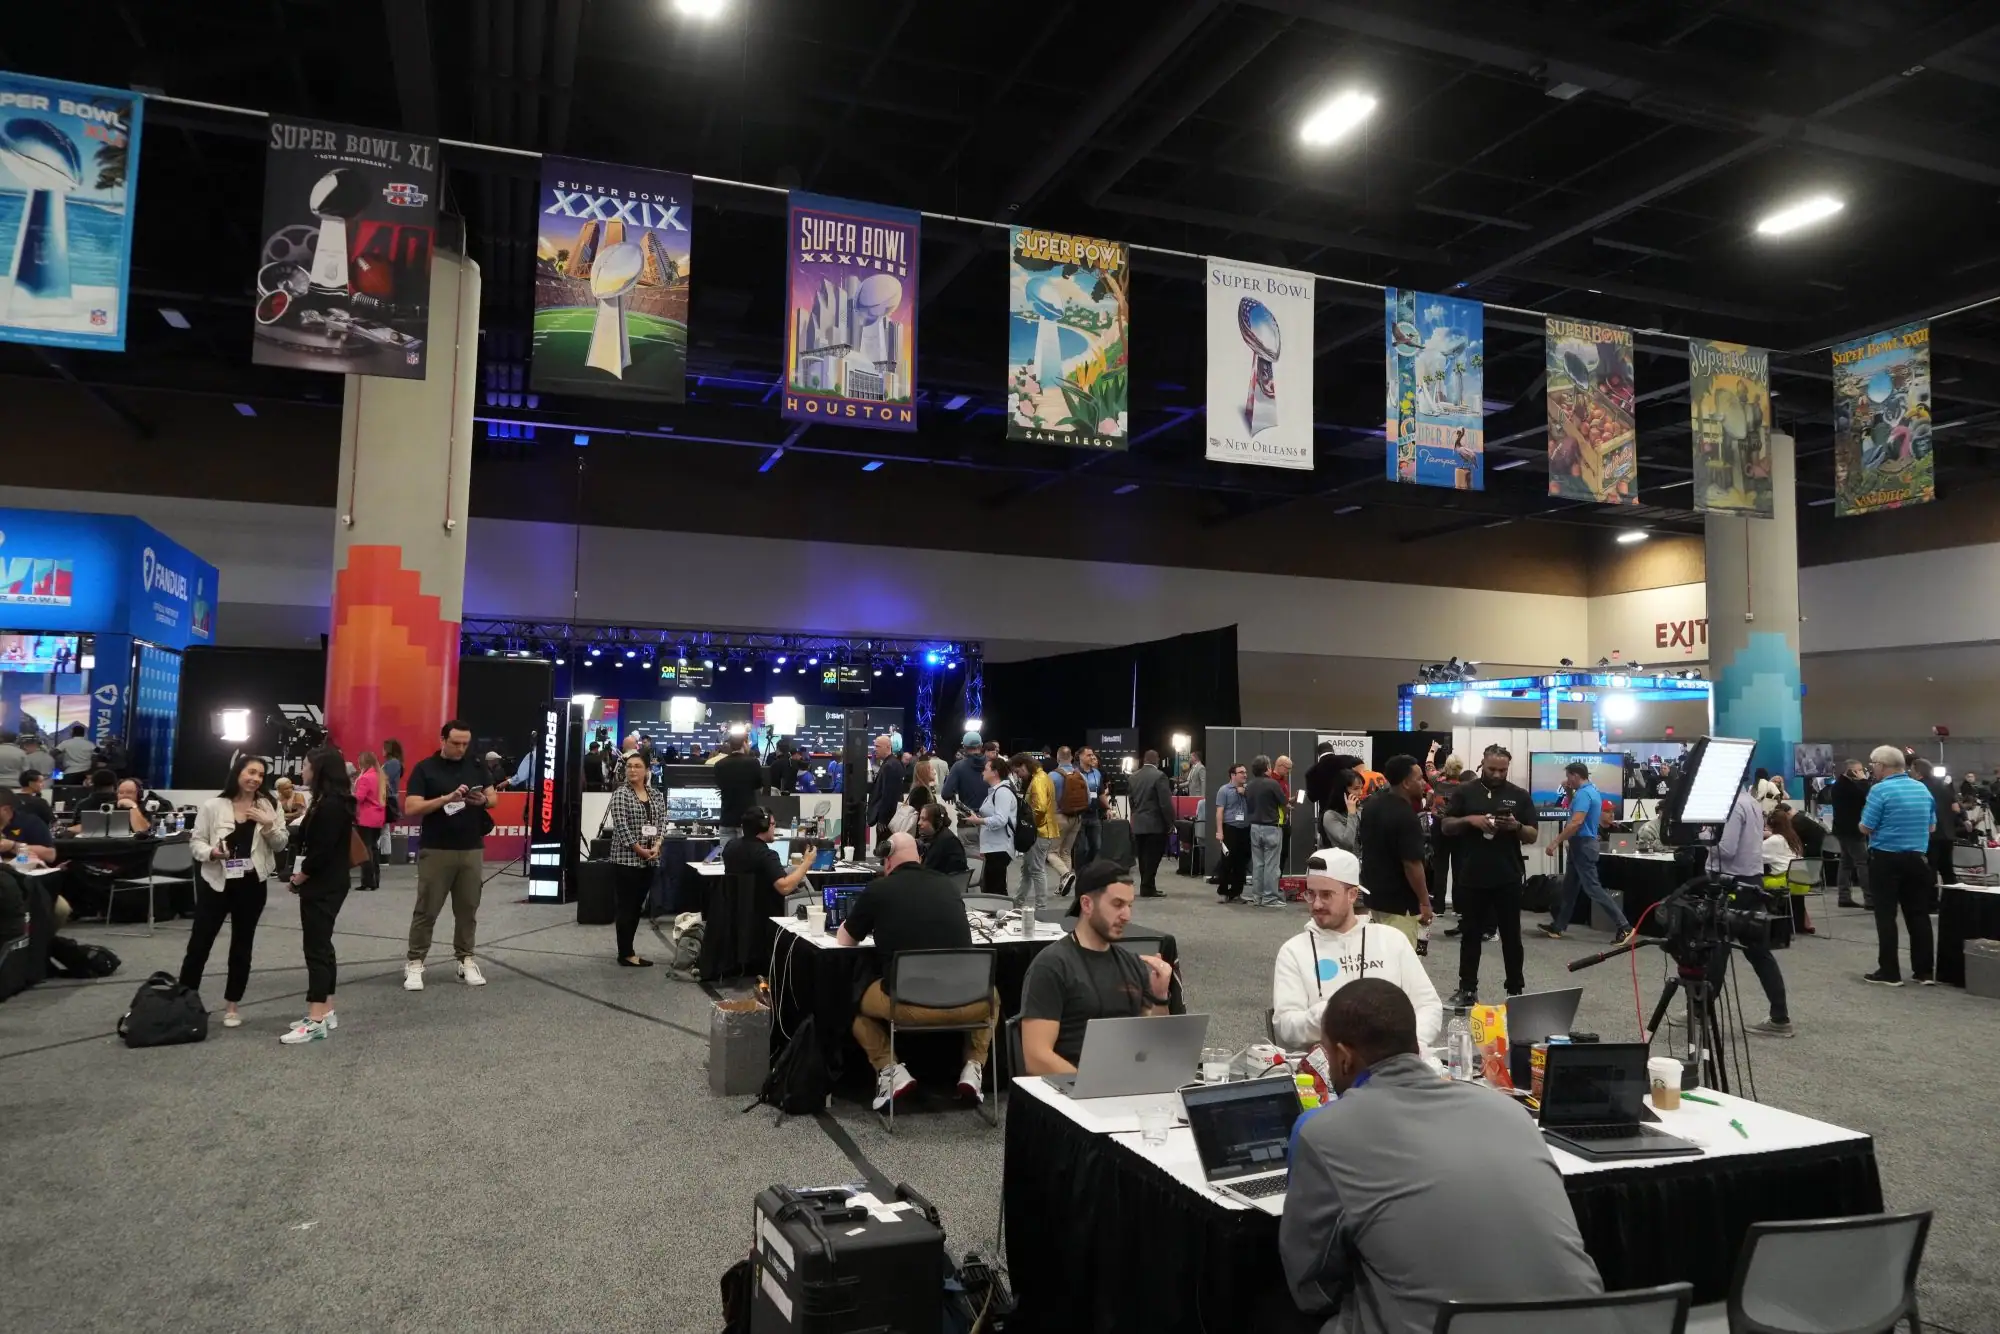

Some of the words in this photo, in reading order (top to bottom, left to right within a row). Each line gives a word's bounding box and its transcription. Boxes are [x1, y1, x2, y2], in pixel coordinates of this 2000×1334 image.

[58, 99, 127, 131] BOWL
[270, 123, 337, 151] SUPER
[345, 134, 401, 162] BOWL
[408, 143, 433, 172] XL
[557, 180, 619, 196] SUPER
[628, 191, 678, 204] BOWL
[544, 188, 689, 232] XXXIX
[801, 217, 857, 254] SUPER
[861, 226, 907, 265] BOWL
[1015, 232, 1071, 257] SUPER
[1074, 242, 1126, 265] BOWL
[800, 252, 907, 277] XXXVIII
[787, 397, 912, 422] HOUSTON
[1025, 430, 1055, 443] SAN
[1064, 434, 1114, 448] DIEGO
[1419, 448, 1457, 467] Tampa
[155, 563, 188, 602] FANDUEL
[16, 595, 61, 605] BOWL
[1656, 619, 1707, 649] EXIT
[661, 665, 676, 673] ON
[541, 710, 559, 822] SPORTSGRID
